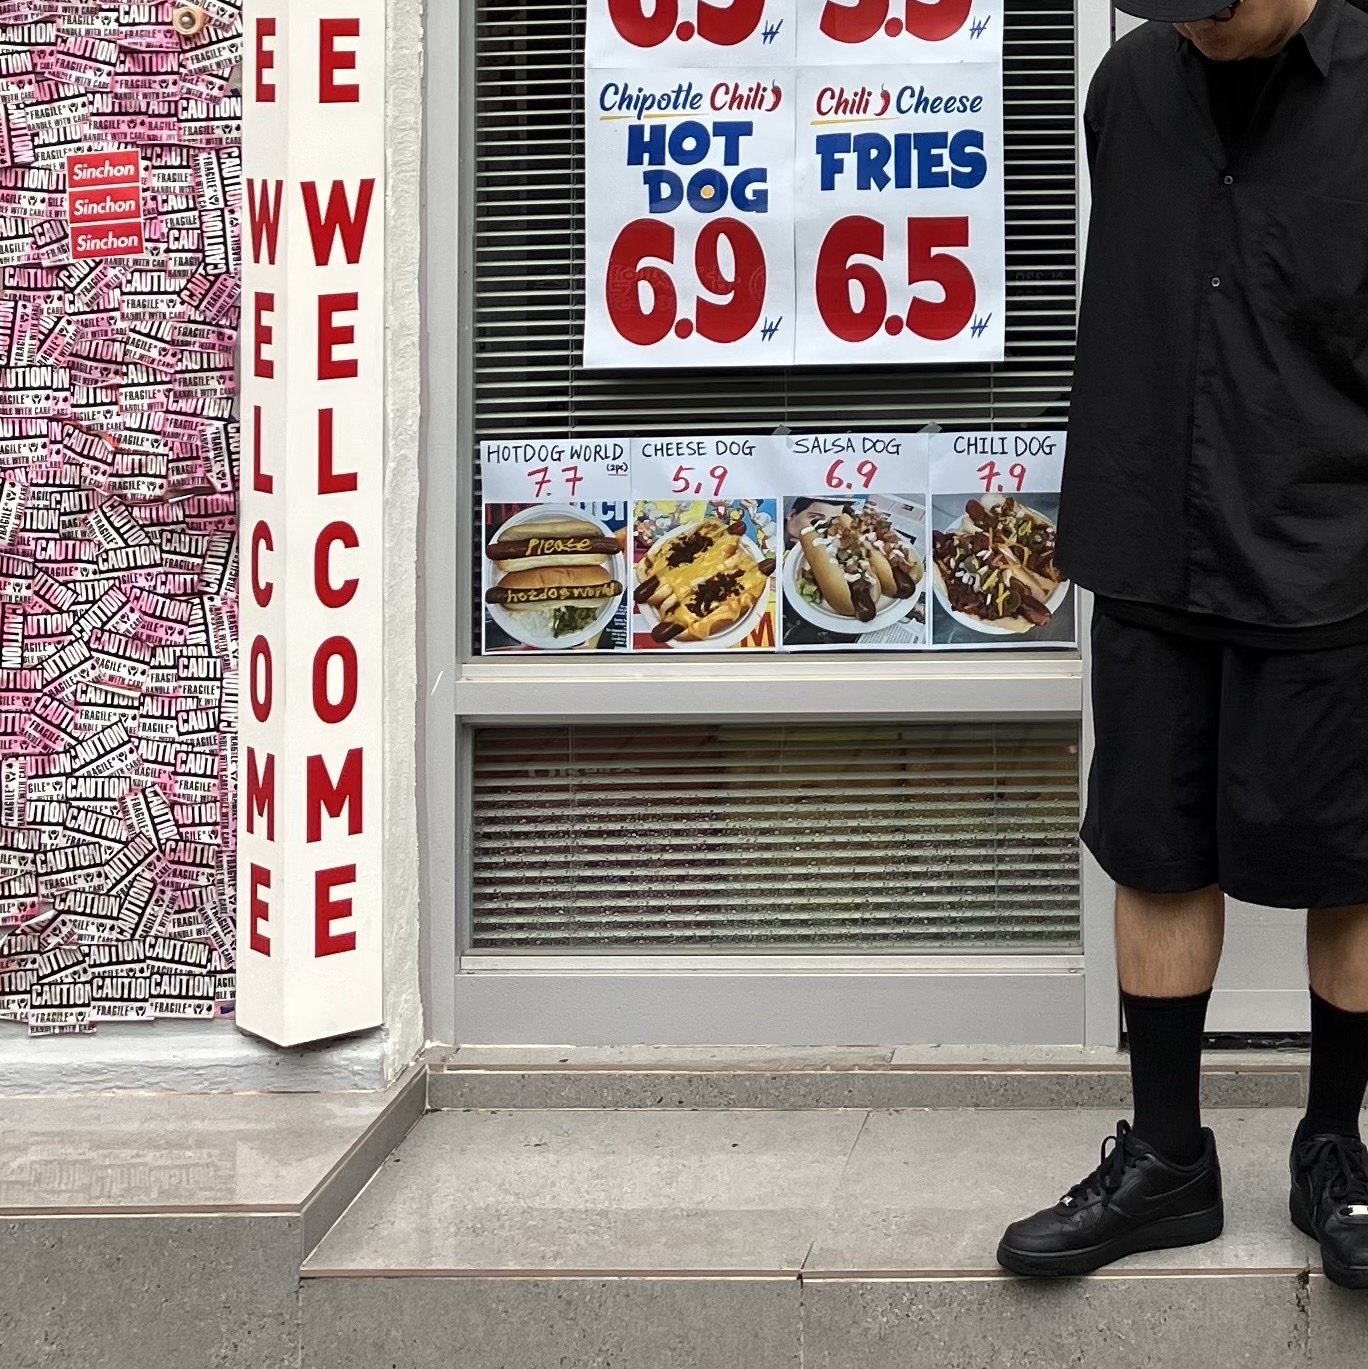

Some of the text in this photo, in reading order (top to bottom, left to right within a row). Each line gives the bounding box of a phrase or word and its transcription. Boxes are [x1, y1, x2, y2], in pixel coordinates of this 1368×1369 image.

[57, 36, 119, 64] CAUTION
[116, 52, 179, 73] CAUTION
[600, 82, 766, 120] Chipotle Chili
[816, 85, 983, 116] Chili Cheese
[626, 120, 753, 166] HOT
[73, 160, 135, 180] Sinchon
[815, 129, 987, 192] FRIES
[643, 167, 768, 214] DOG
[74, 195, 136, 216] Sinchon
[76, 231, 139, 252] Sinchon
[606, 217, 766, 346] 6.9
[815, 215, 976, 343] 6.5
[487, 443, 624, 463] HOTDOG WORLD
[642, 440, 756, 458] CHEESE DOG
[793, 436, 902, 455] SALSA DOG
[953, 435, 1057, 456] CHILI DOG
[606, 463, 629, 474] (2pc)
[825, 459, 878, 489] 6.9
[246, 178, 284, 957] WELCOME
[300, 178, 375, 958] WELCOME
[36, 843, 101, 871] CAUTION
[54, 892, 120, 918] CAUTION
[146, 938, 210, 968] CAUTION
[151, 974, 216, 998] CAUTION
